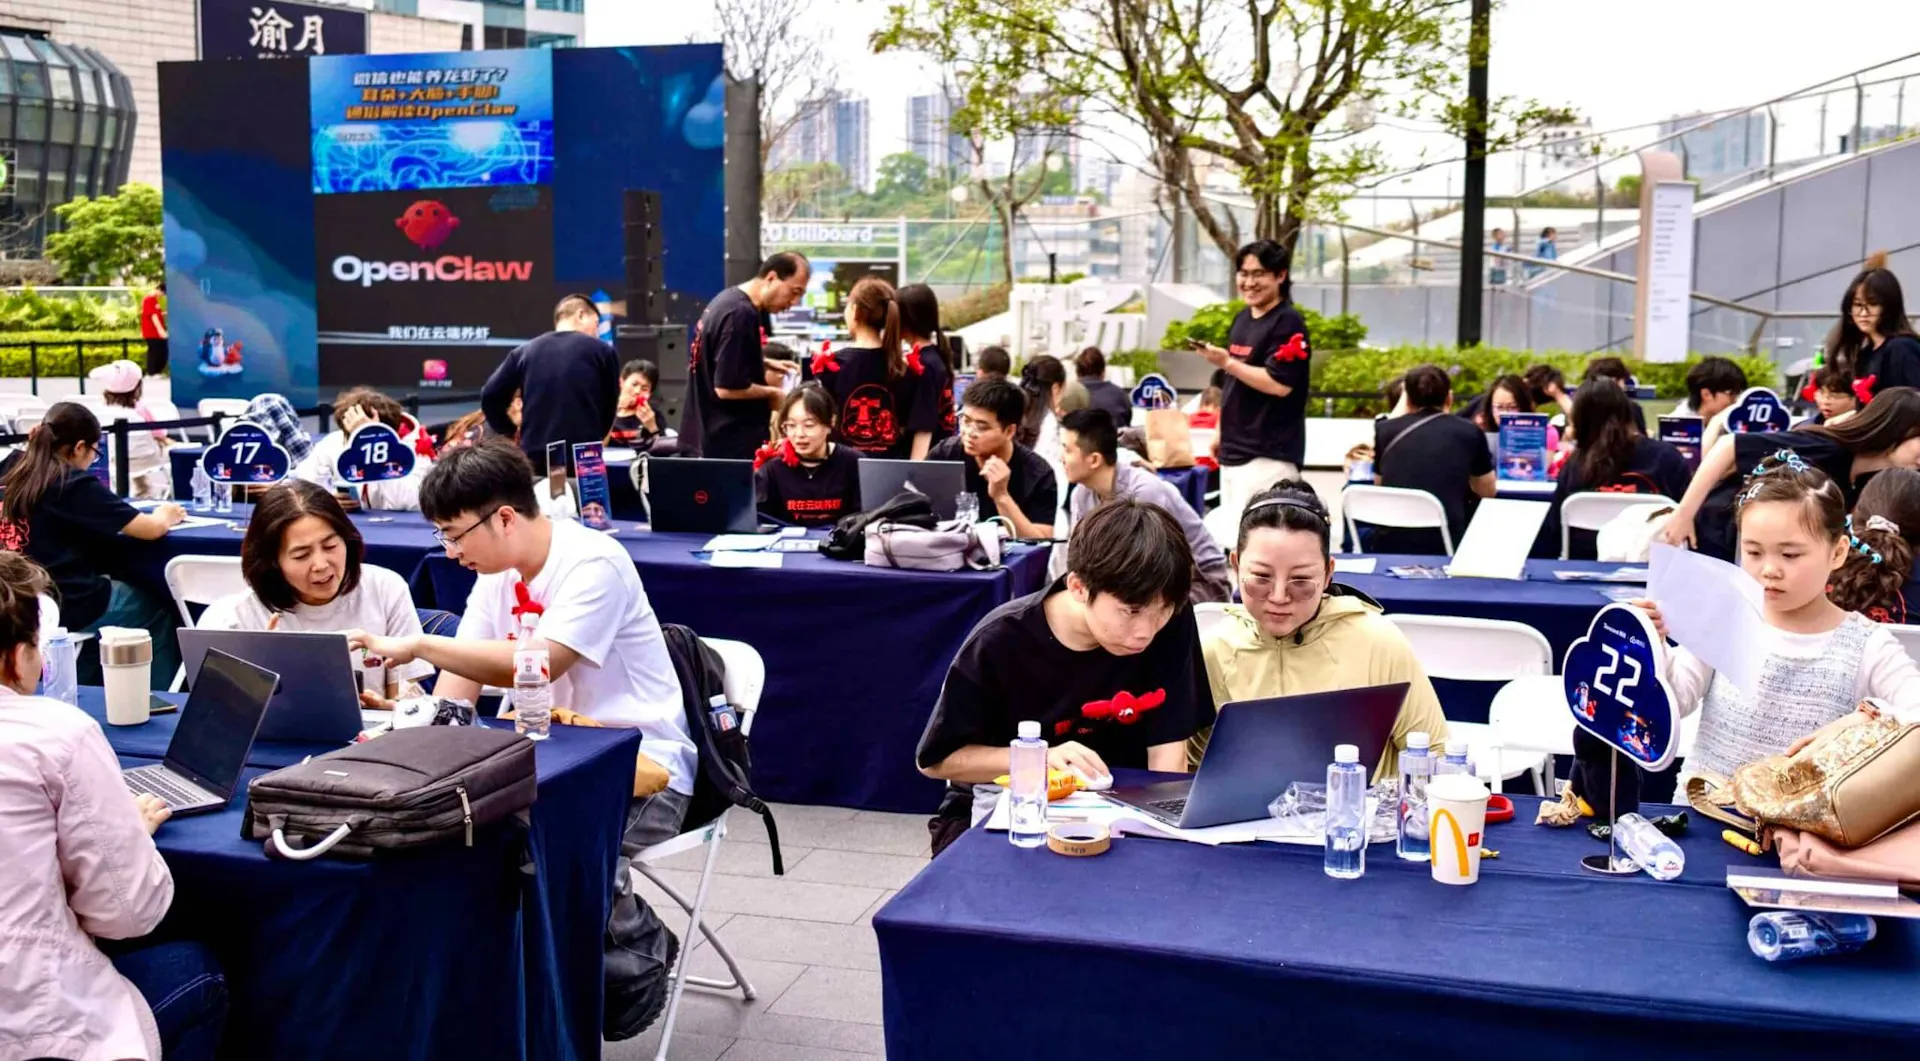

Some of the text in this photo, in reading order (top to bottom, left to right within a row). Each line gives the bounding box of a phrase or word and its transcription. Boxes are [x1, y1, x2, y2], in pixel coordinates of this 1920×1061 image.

[249, 7, 325, 54] 渝月
[788, 225, 873, 242] Billboard
[332, 255, 533, 287] OpenClaw
[388, 325, 491, 341] 我们在云端养虾
[1747, 403, 1772, 422] 10
[232, 441, 261, 464] 17
[360, 440, 389, 465] 18
[1593, 643, 1641, 708] 22
